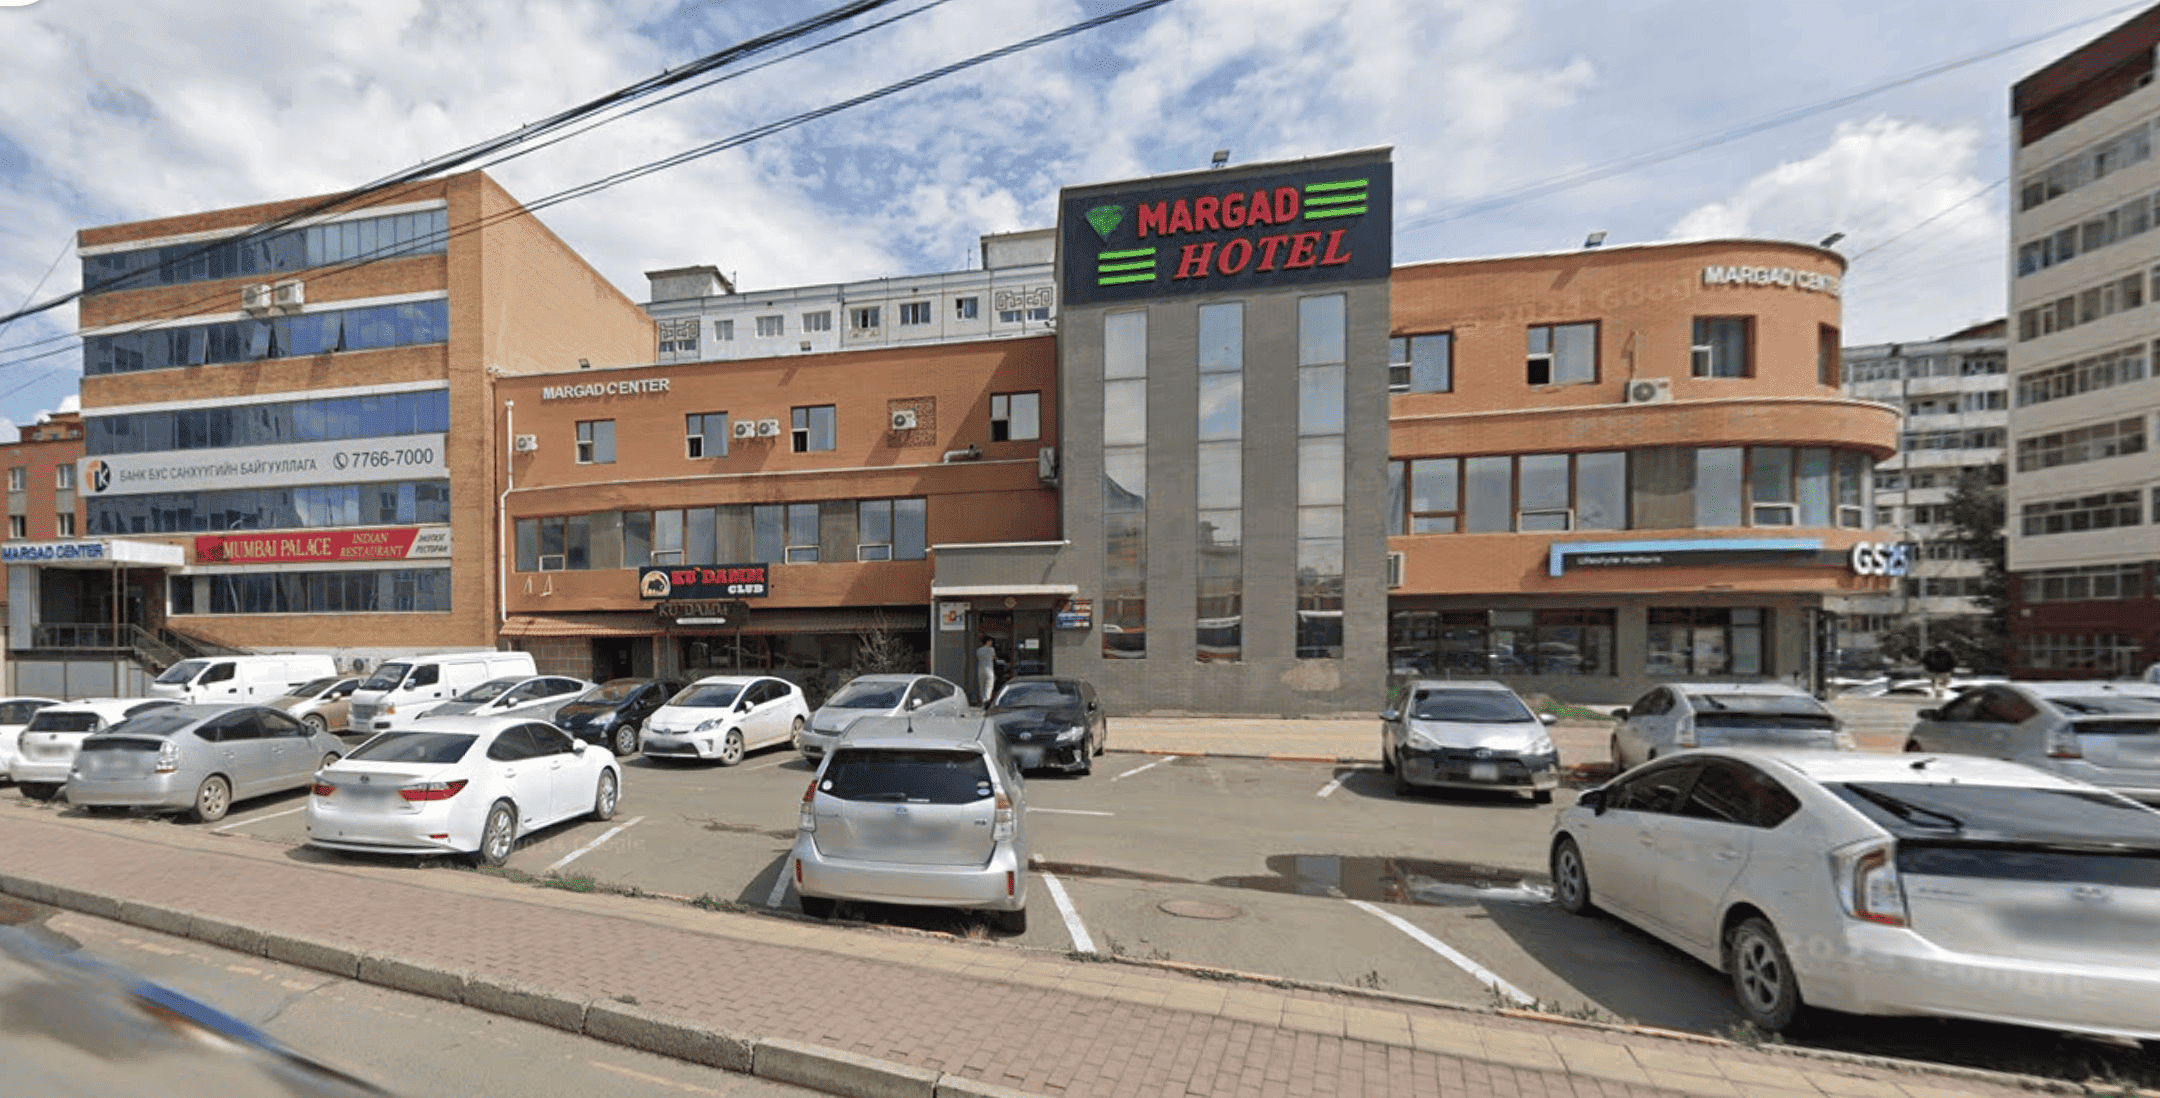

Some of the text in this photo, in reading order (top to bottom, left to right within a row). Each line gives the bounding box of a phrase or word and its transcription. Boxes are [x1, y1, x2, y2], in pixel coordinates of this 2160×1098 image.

[1136, 187, 1300, 240] MARGAD
[1172, 229, 1352, 281] HOTEL
[1704, 265, 1795, 286] MARGAD
[543, 377, 670, 400] MARGAD CENTER
[352, 448, 434, 468] 7766-7000
[119, 468, 146, 482] БАНК
[148, 467, 168, 480] БУС
[240, 458, 318, 475] БАЙГУУЛЛАГА
[222, 537, 332, 559] MUMBAI PALACE
[352, 532, 388, 544] INDIAN
[1, 543, 104, 560] MARGAD CENTER
[340, 545, 404, 557] RESTAURANT
[1853, 541, 1908, 576] GS25
[728, 583, 764, 594] CLUB
